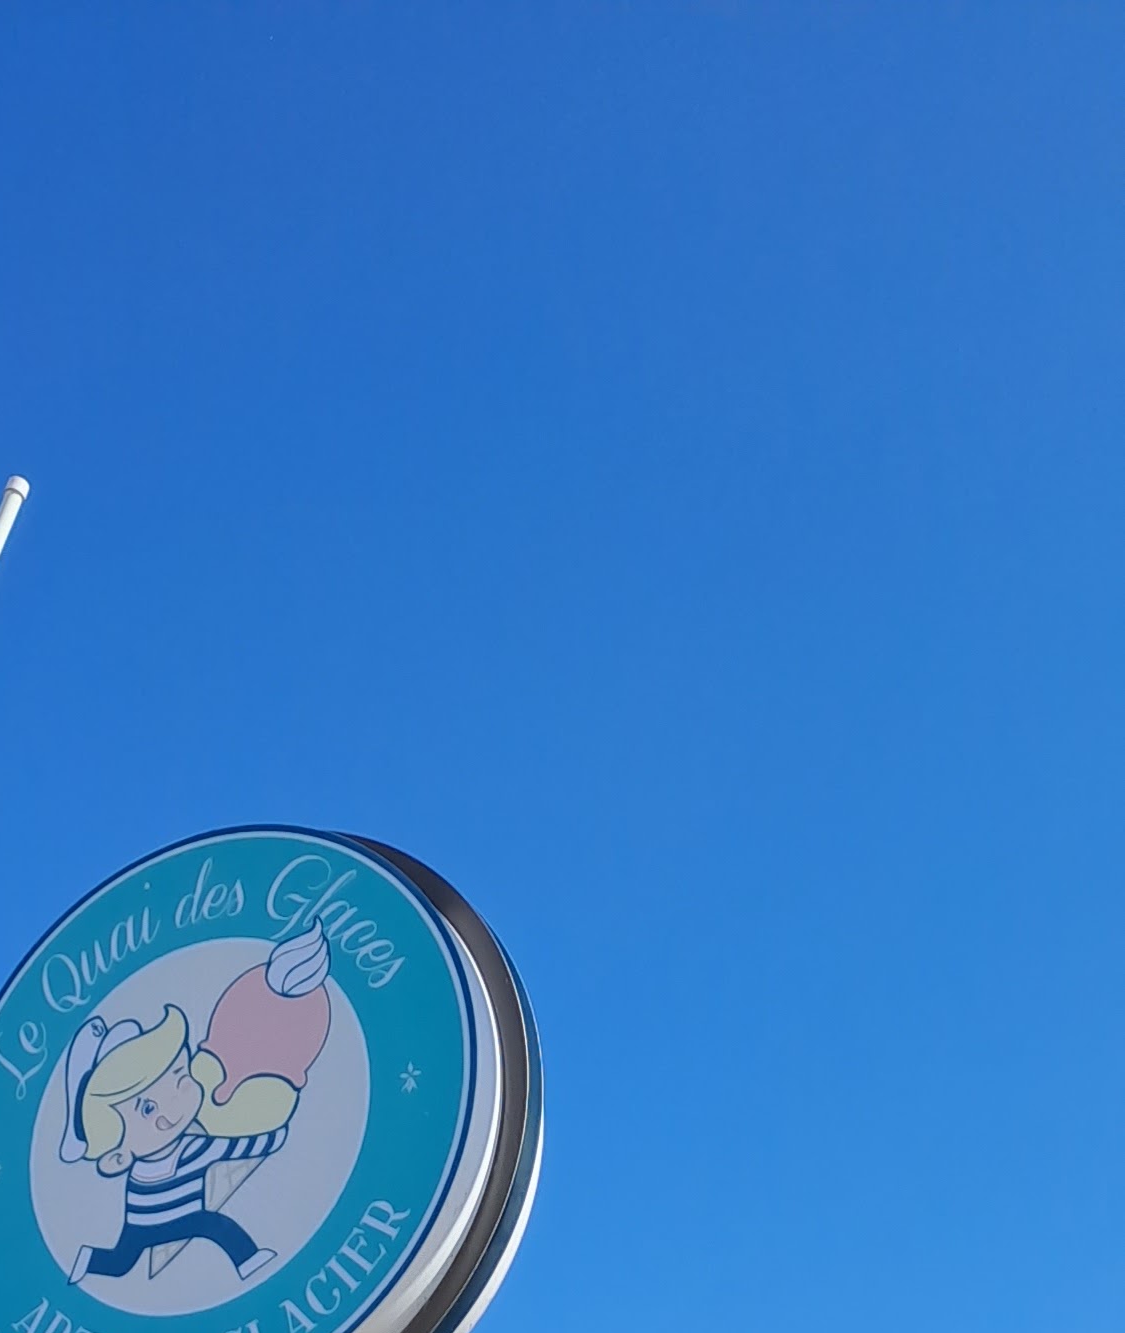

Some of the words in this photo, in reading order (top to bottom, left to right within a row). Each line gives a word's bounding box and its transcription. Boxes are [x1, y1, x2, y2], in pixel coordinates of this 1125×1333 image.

[41, 882, 160, 1014] Quai
[175, 857, 245, 931] des
[266, 853, 409, 990] Glaces
